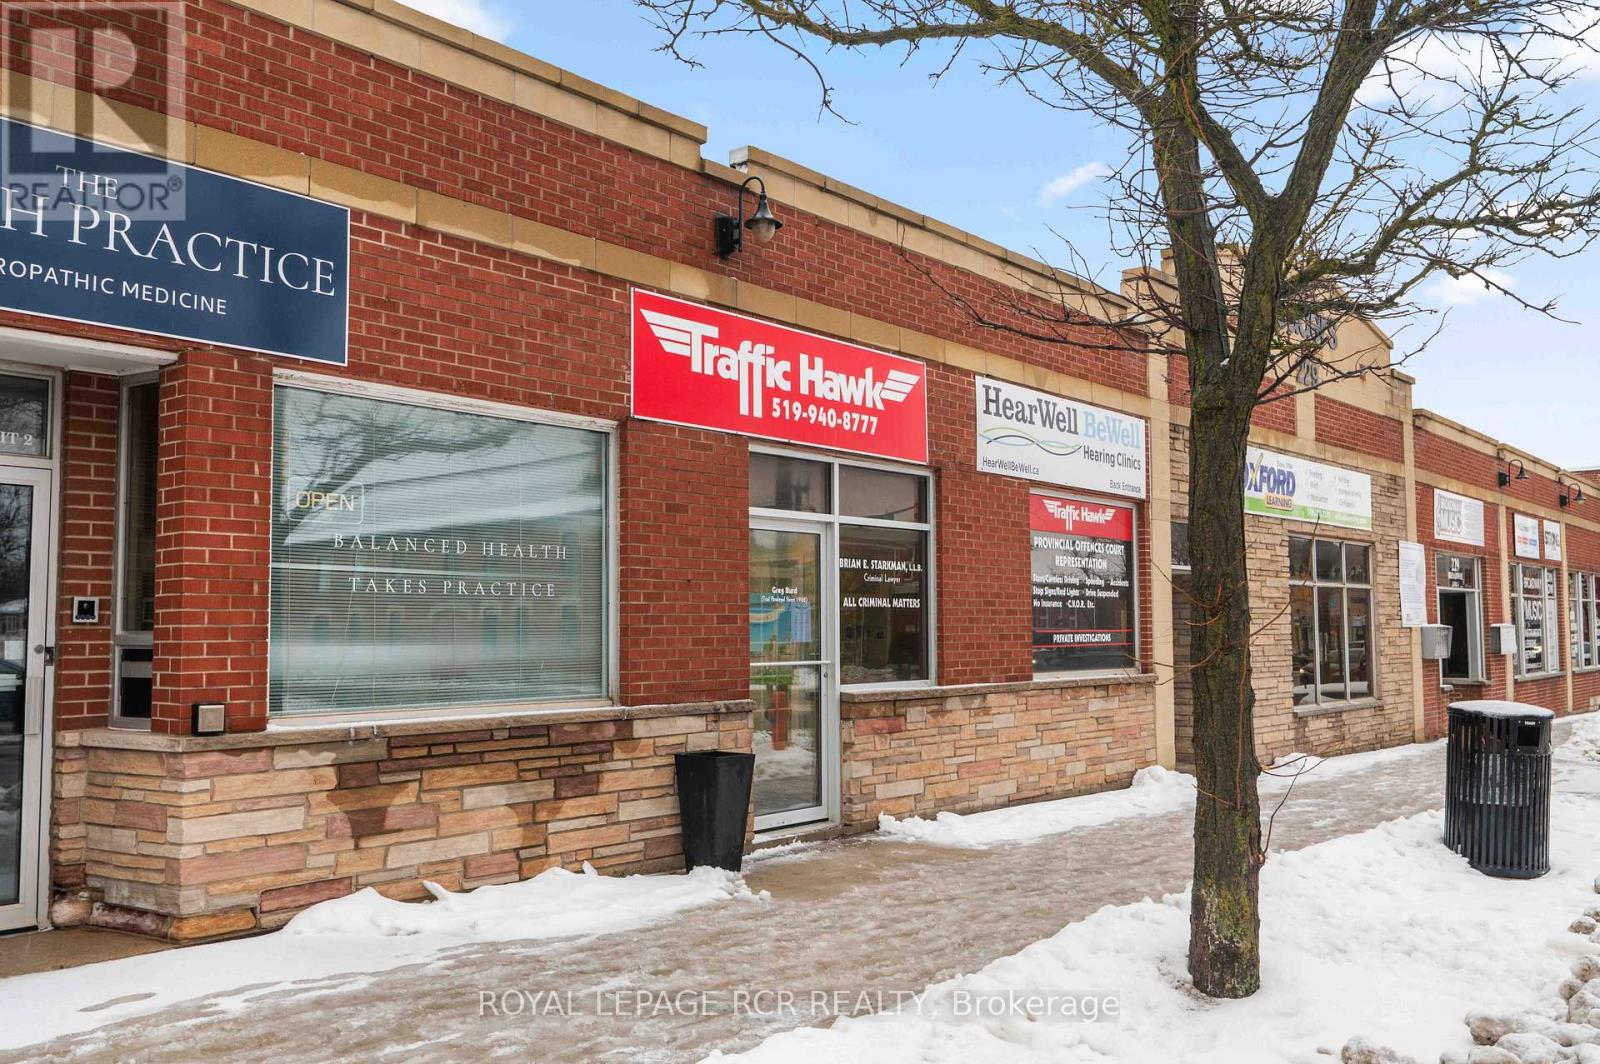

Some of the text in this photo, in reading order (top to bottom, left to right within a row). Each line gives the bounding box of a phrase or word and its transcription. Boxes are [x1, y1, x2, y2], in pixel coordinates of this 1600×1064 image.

[55, 165, 119, 200] THE
[67, 201, 336, 298] PRACTICE
[121, 280, 228, 316] MEDICINE
[640, 308, 885, 418] Traffic Hawk
[771, 398, 878, 436] 519-940-8777
[982, 384, 1142, 450] HearWell BeWell
[23, 433, 33, 446] 2
[982, 456, 1040, 476] HearWellBeWell.ca
[1083, 445, 1141, 471] Hearing Clinics
[296, 490, 355, 512] OPEN
[1266, 495, 1293, 509] LEARNING
[1042, 500, 1106, 531] Traffic Hawk
[334, 533, 568, 561] BALANCED HEALTH
[1033, 536, 1126, 557] PROVINCIAL OFFENCES COURT
[839, 558, 861, 569] BRIAN
[862, 559, 870, 569] E.
[871, 560, 908, 573] STARKMAN,
[1055, 555, 1108, 570] REPRESENTATION
[348, 577, 556, 598] TAKES PRACTICE
[863, 572, 901, 584] Criminal Lawyer
[771, 586, 785, 595] Greg
[843, 596, 921, 609] ALL CRIMINAL MATTERS
[1033, 599, 1041, 608] No
[1053, 632, 1112, 643] PRIVATE INVESTIGATIONS
